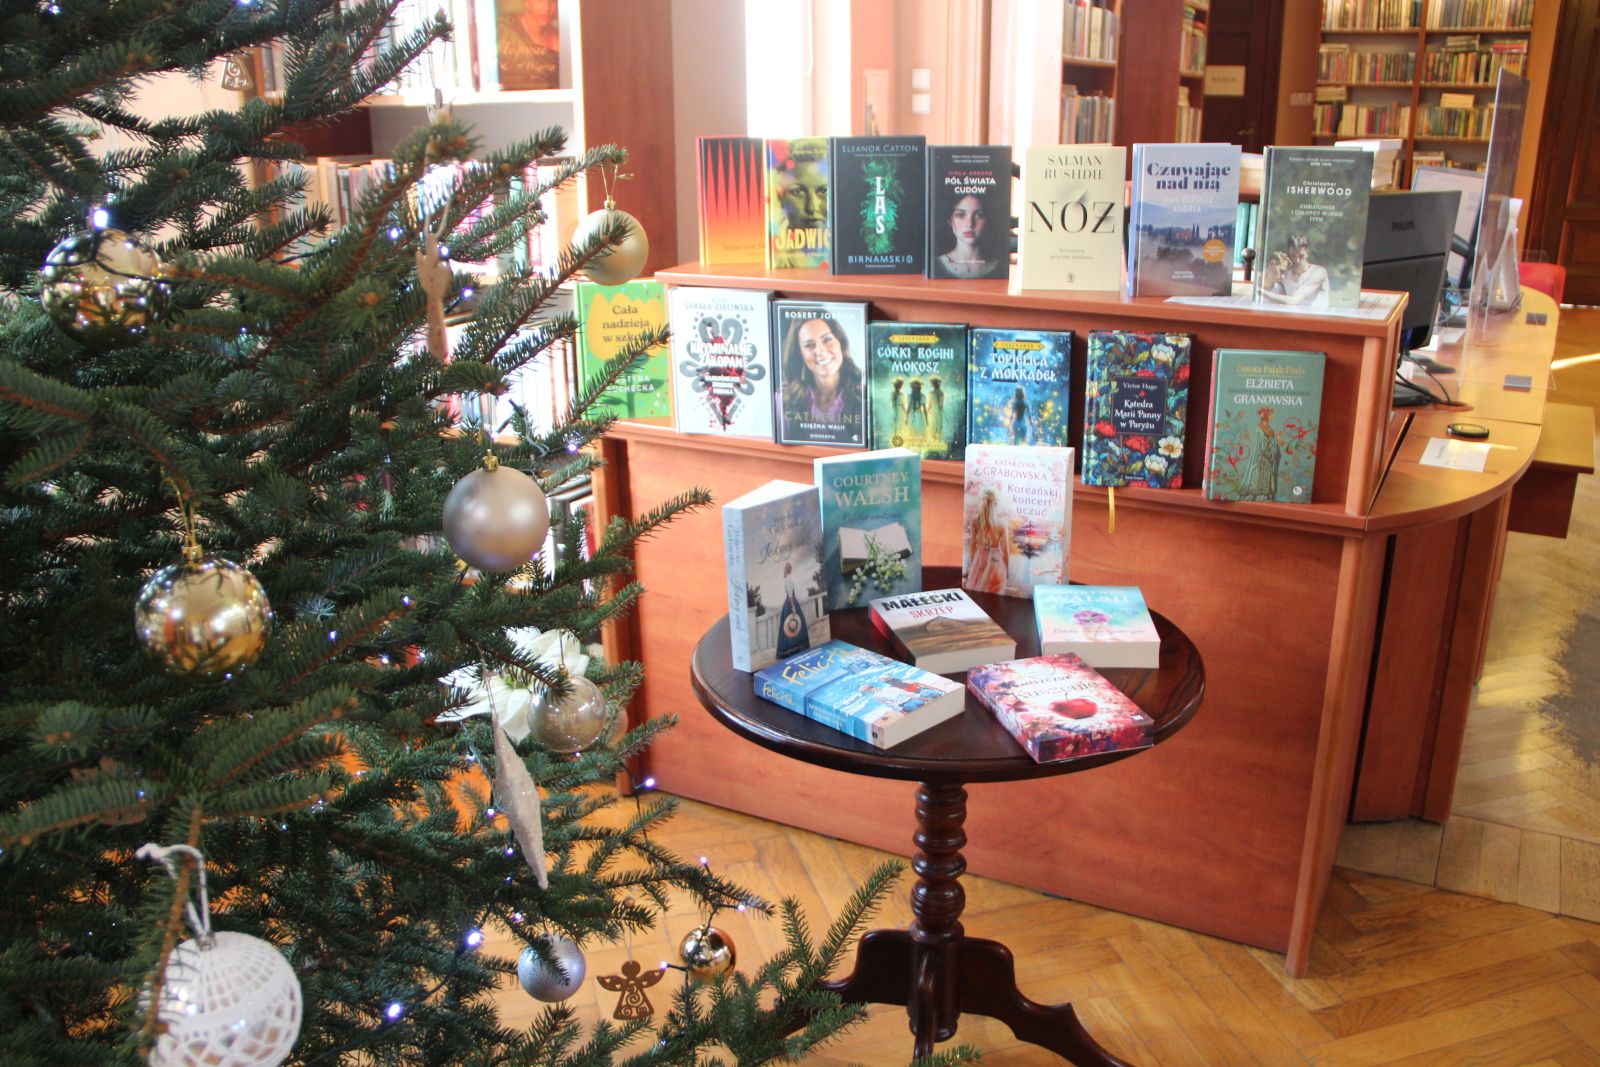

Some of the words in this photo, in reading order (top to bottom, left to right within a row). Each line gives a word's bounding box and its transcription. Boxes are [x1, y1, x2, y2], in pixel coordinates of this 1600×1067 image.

[842, 144, 880, 153] ELEANOR
[884, 144, 918, 153] CATTON
[1048, 155, 1103, 166] SALMAN
[1044, 169, 1106, 180] RUSHDIE
[1147, 162, 1231, 179] Czuwając
[944, 176, 962, 185] PÓŁ
[964, 176, 996, 185] ŚWIATA
[1156, 176, 1188, 190] nad
[1193, 178, 1220, 192] nią
[954, 185, 986, 194] CUDÓW
[1286, 185, 1352, 196] ISHERWOOD
[848, 255, 905, 264] BIRNAMSKI
[612, 304, 638, 315] Cała
[784, 311, 817, 319] ROBERT
[602, 317, 650, 330] nadzieja
[877, 344, 911, 359] CÓRKI
[917, 347, 954, 360] BOGINI
[990, 353, 1048, 368] TOPIELICA
[891, 361, 940, 374] MOKOSZ
[980, 366, 988, 380] Z
[991, 367, 1057, 382] MOKRADEŁ
[1245, 376, 1294, 390] ELŻBIETA
[1124, 399, 1153, 409] Katedra
[1233, 393, 1303, 406] GRANOWSKA
[784, 411, 860, 424] CATHERINE
[1114, 409, 1136, 419] Marii
[1137, 410, 1162, 422] Panny
[800, 422, 826, 430] KSIĘŻNA
[1128, 419, 1155, 431] Paryżu
[994, 459, 1036, 469] KATARZYNA
[833, 471, 909, 488] COURTNEY
[982, 467, 1048, 481] GRABOWSKA
[833, 485, 910, 508] WALSH
[1007, 484, 1058, 497] Koreański
[1012, 495, 1052, 507] koncert
[1016, 506, 1048, 517] uczuć
[881, 591, 964, 611] MAŁECKI
[909, 605, 954, 619] SKRZEP
